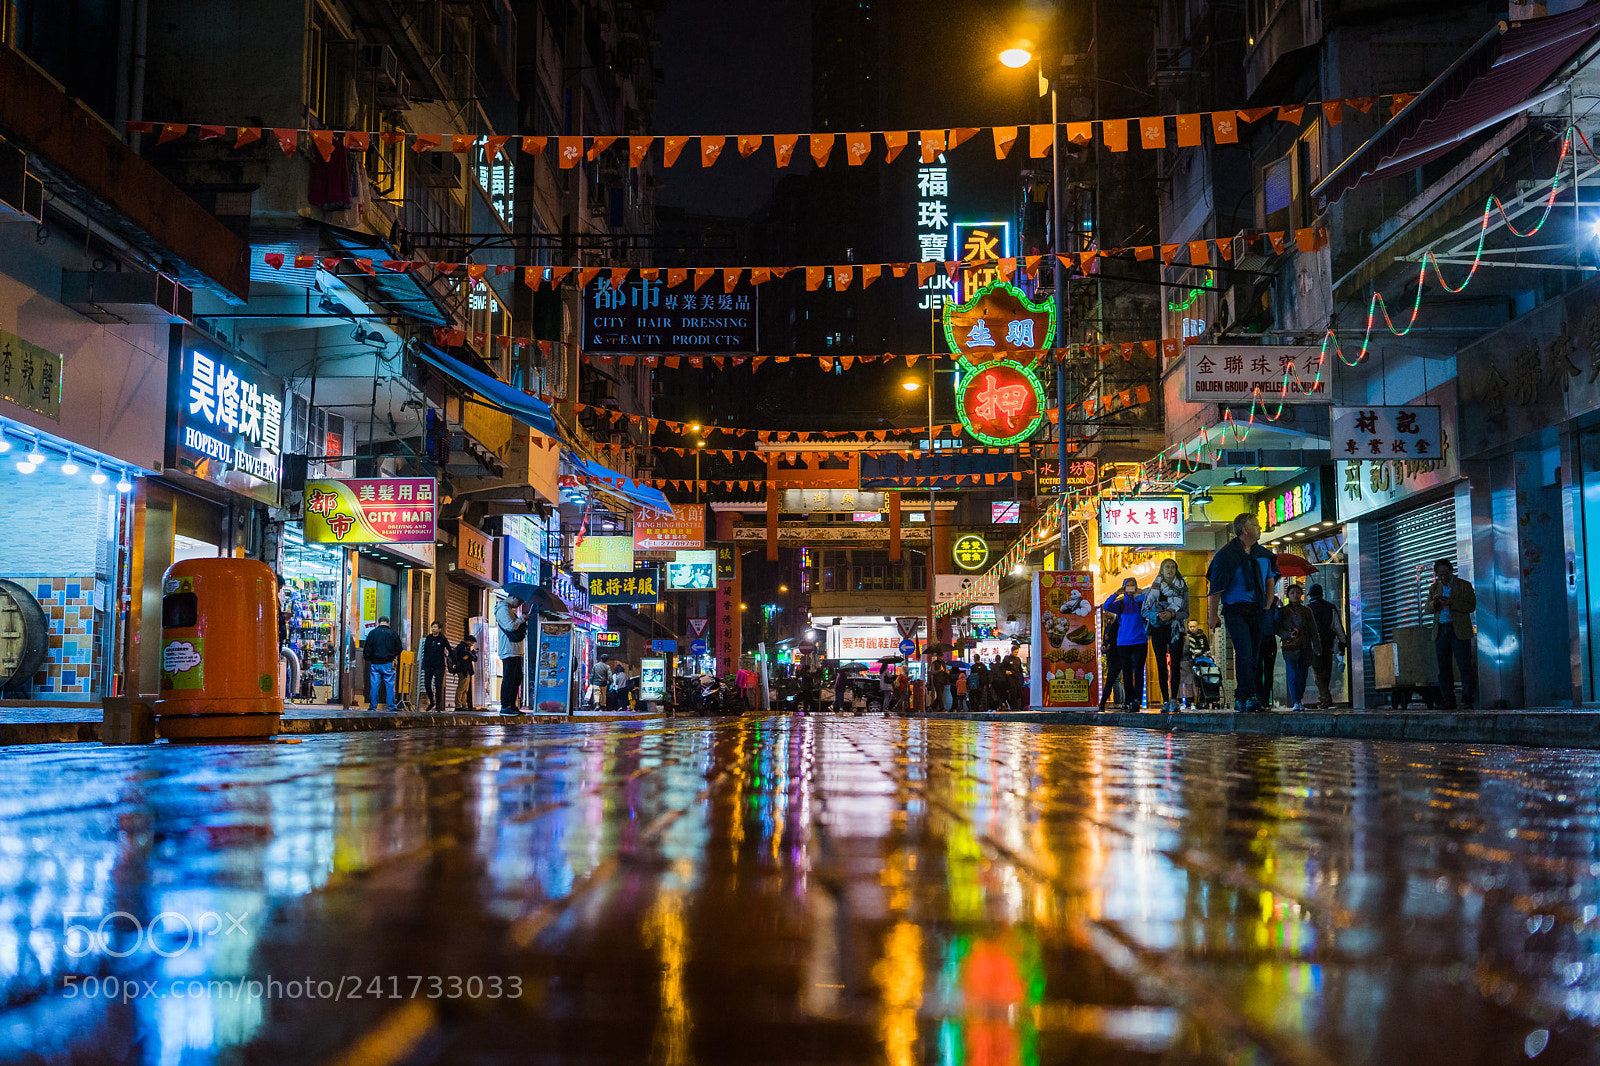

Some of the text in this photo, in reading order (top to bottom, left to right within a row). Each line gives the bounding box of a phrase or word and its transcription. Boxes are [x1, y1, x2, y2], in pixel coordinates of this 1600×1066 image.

[665, 294, 750, 310] 專業美髮品
[593, 317, 747, 327] CITY HAIR DRESSING
[593, 335, 602, 344] &
[672, 335, 740, 344] PRODUCTS
[1196, 354, 1325, 376] 金聯珠寶行
[1195, 380, 1223, 392] GOLDEN
[1225, 380, 1248, 393] GROUP
[1250, 381, 1290, 393] JEWELLERY
[976, 374, 1028, 429] 押
[1344, 439, 1431, 454] 專業收金
[185, 426, 279, 482] HOPEFUL JEWELRY
[1040, 463, 1084, 476] 水坊
[360, 485, 432, 501] 美髮用品
[367, 511, 432, 522] CITY HAIR
[1103, 531, 1182, 539] MING SANG PAWN SHOP
[589, 577, 656, 596] 龍將洋服
[842, 637, 901, 649] 愛琦麗鞋屋
